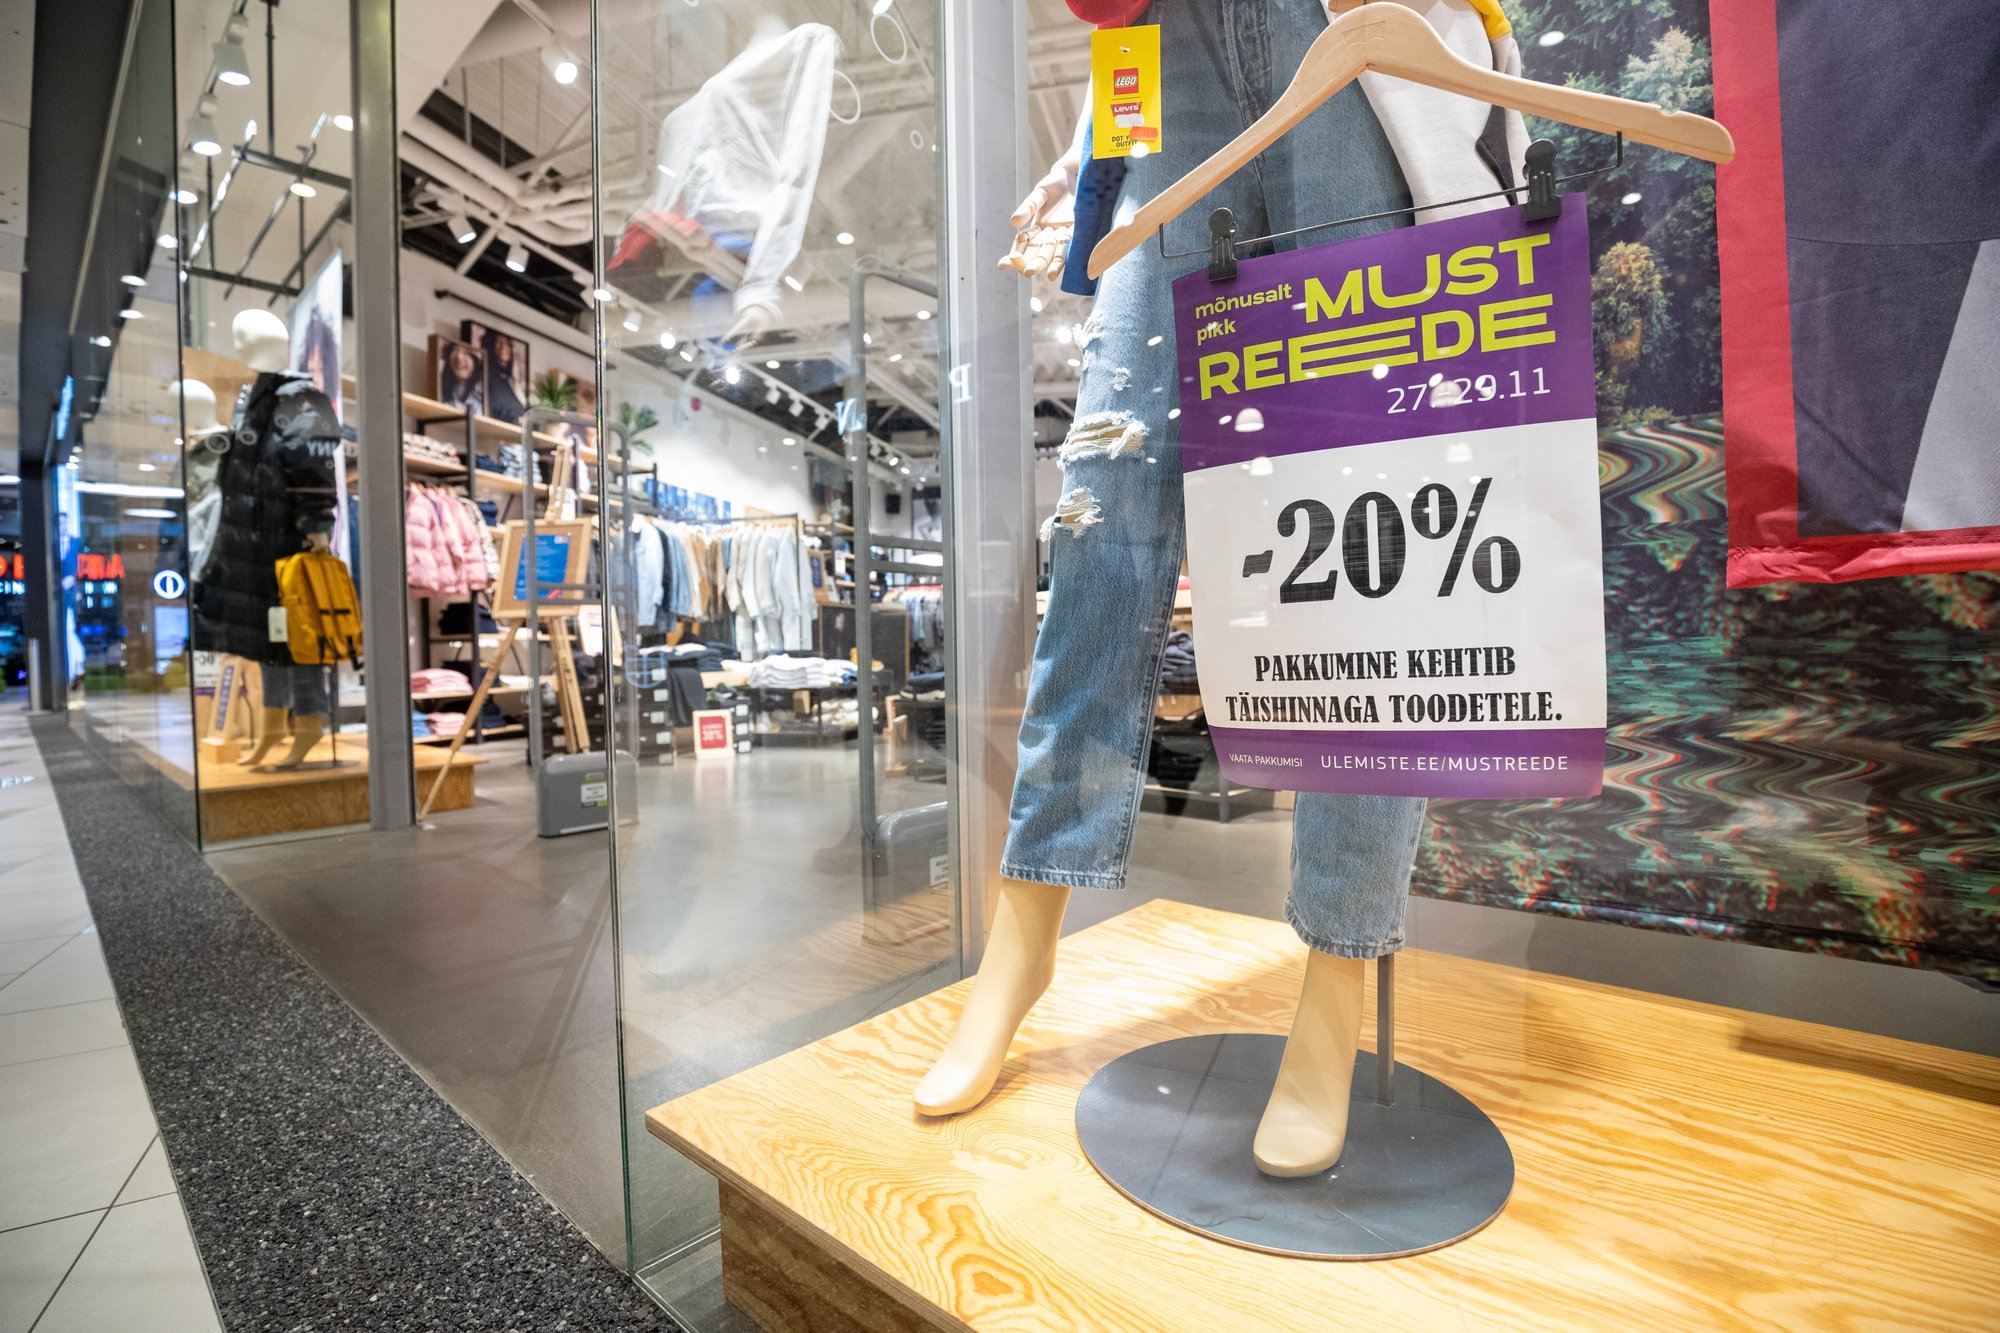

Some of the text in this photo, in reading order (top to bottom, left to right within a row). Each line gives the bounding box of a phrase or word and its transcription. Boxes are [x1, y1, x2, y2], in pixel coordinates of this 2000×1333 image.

[1115, 76, 1136, 87] LEGO
[1195, 232, 1551, 324] mõnusalt MUST
[1197, 318, 1236, 346] pikk
[1198, 293, 1556, 401] REEDE
[1242, 477, 1521, 604] -20%
[1254, 645, 1516, 682] PAKKUMINE KEHTIB
[1225, 691, 1563, 724] TÄISHINNAGA TOODETELE.
[1229, 753, 1568, 772] VAATA PAKKUMISI ULEMISTE.EE/MUSTREEDE
